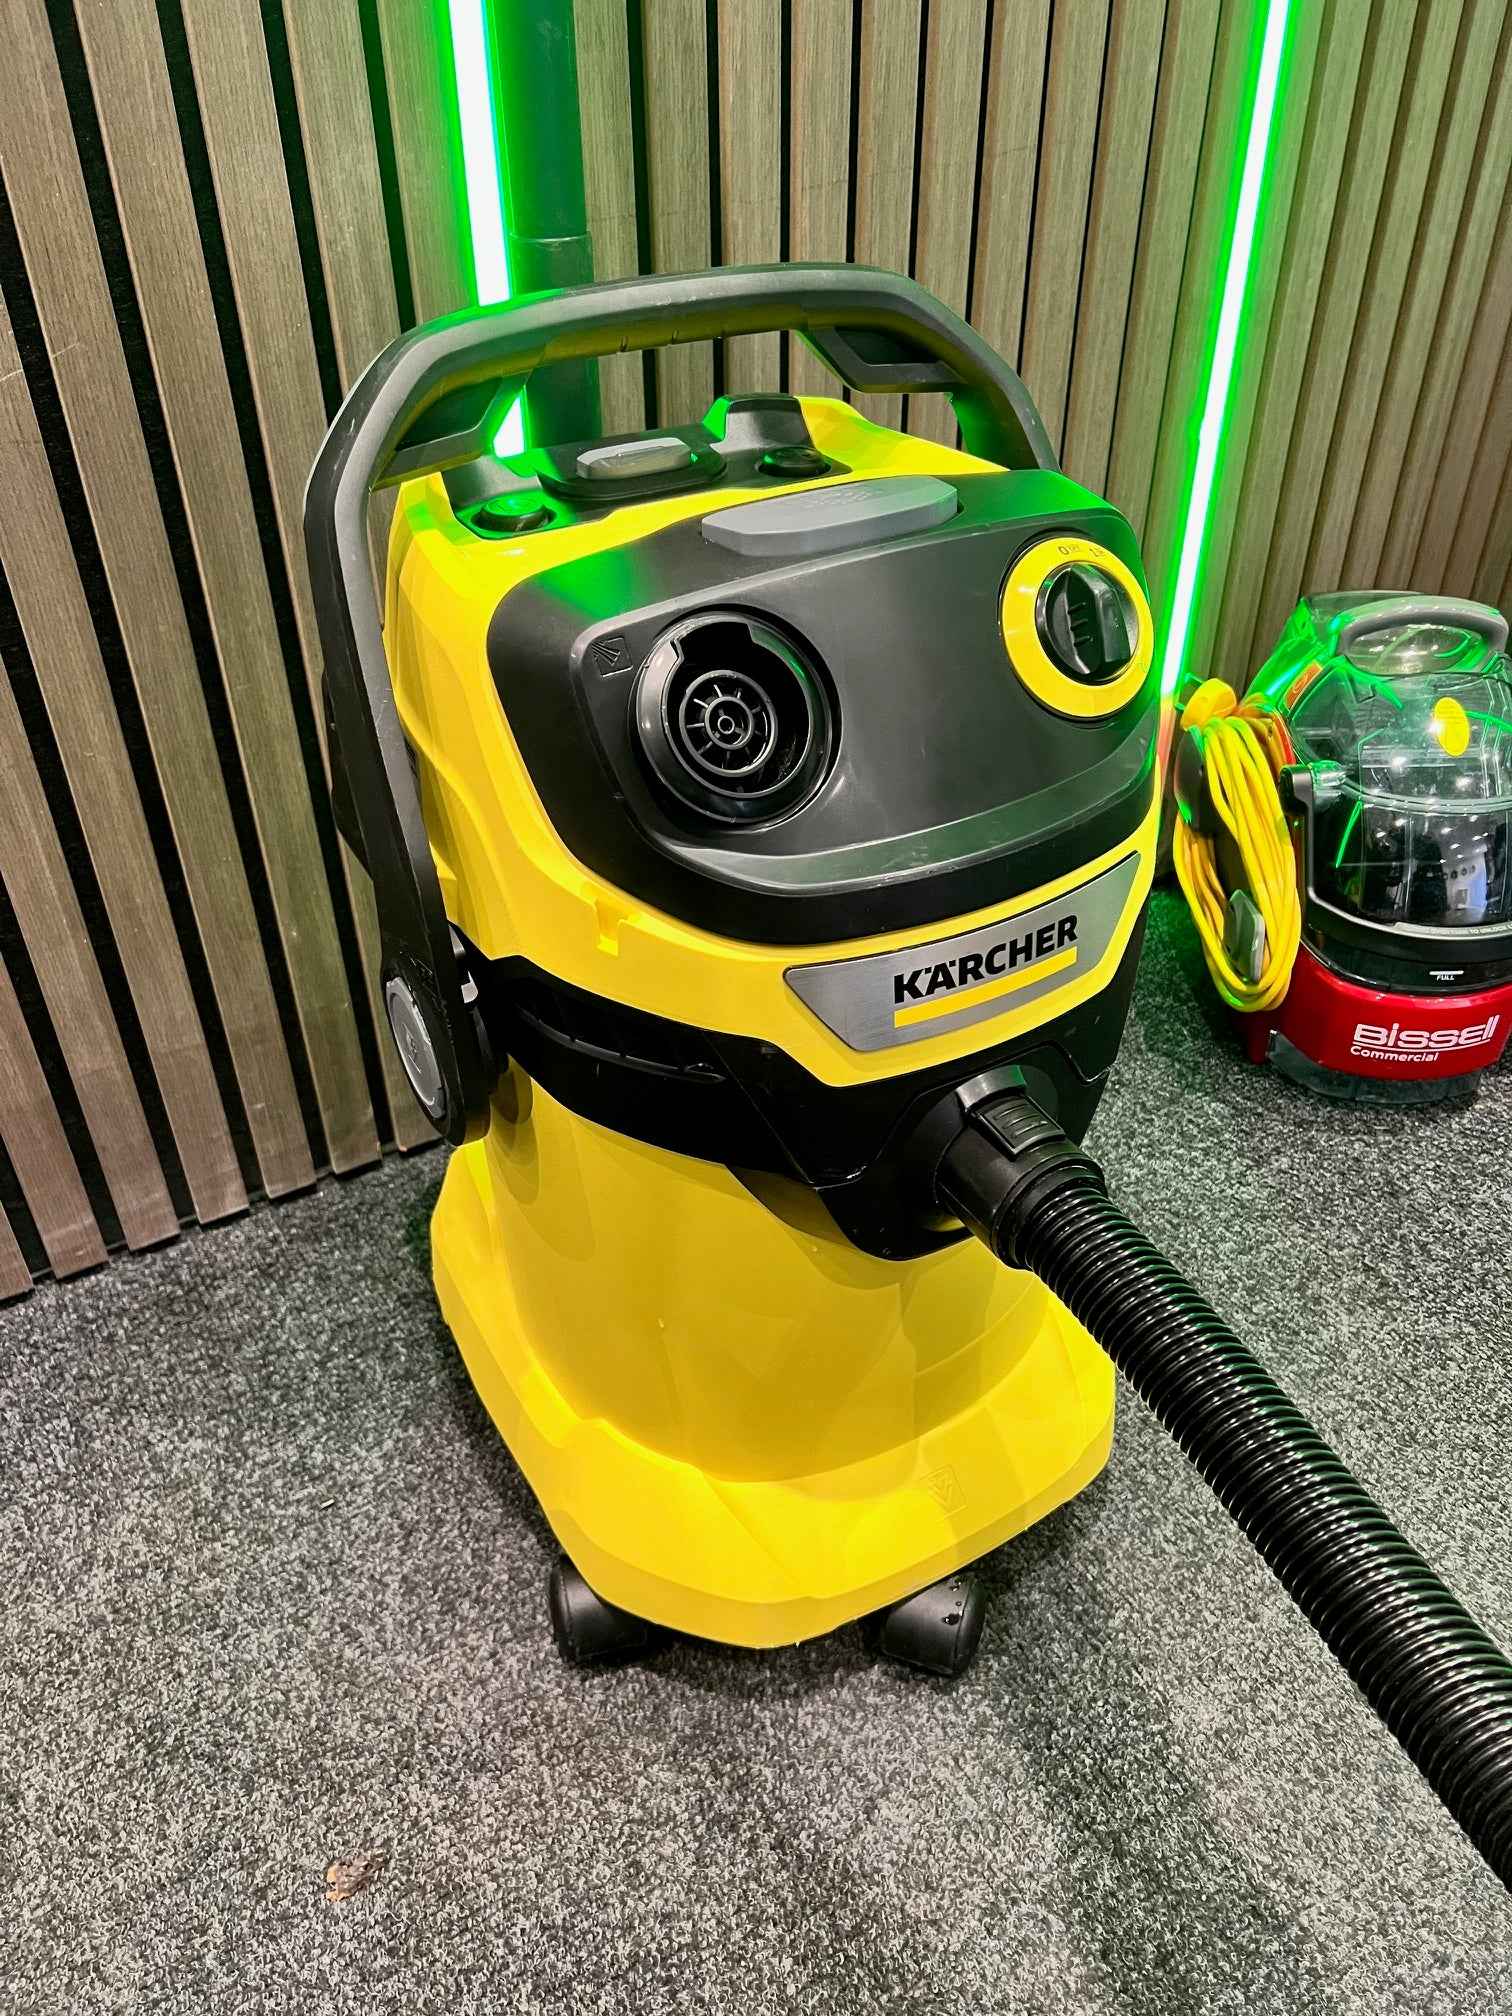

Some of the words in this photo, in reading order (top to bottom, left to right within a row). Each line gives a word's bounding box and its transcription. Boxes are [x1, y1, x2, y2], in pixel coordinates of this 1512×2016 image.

[893, 914, 1078, 1004] KÄRCHER
[1436, 973, 1455, 981] FULL
[1350, 1045, 1439, 1062] Commercial
